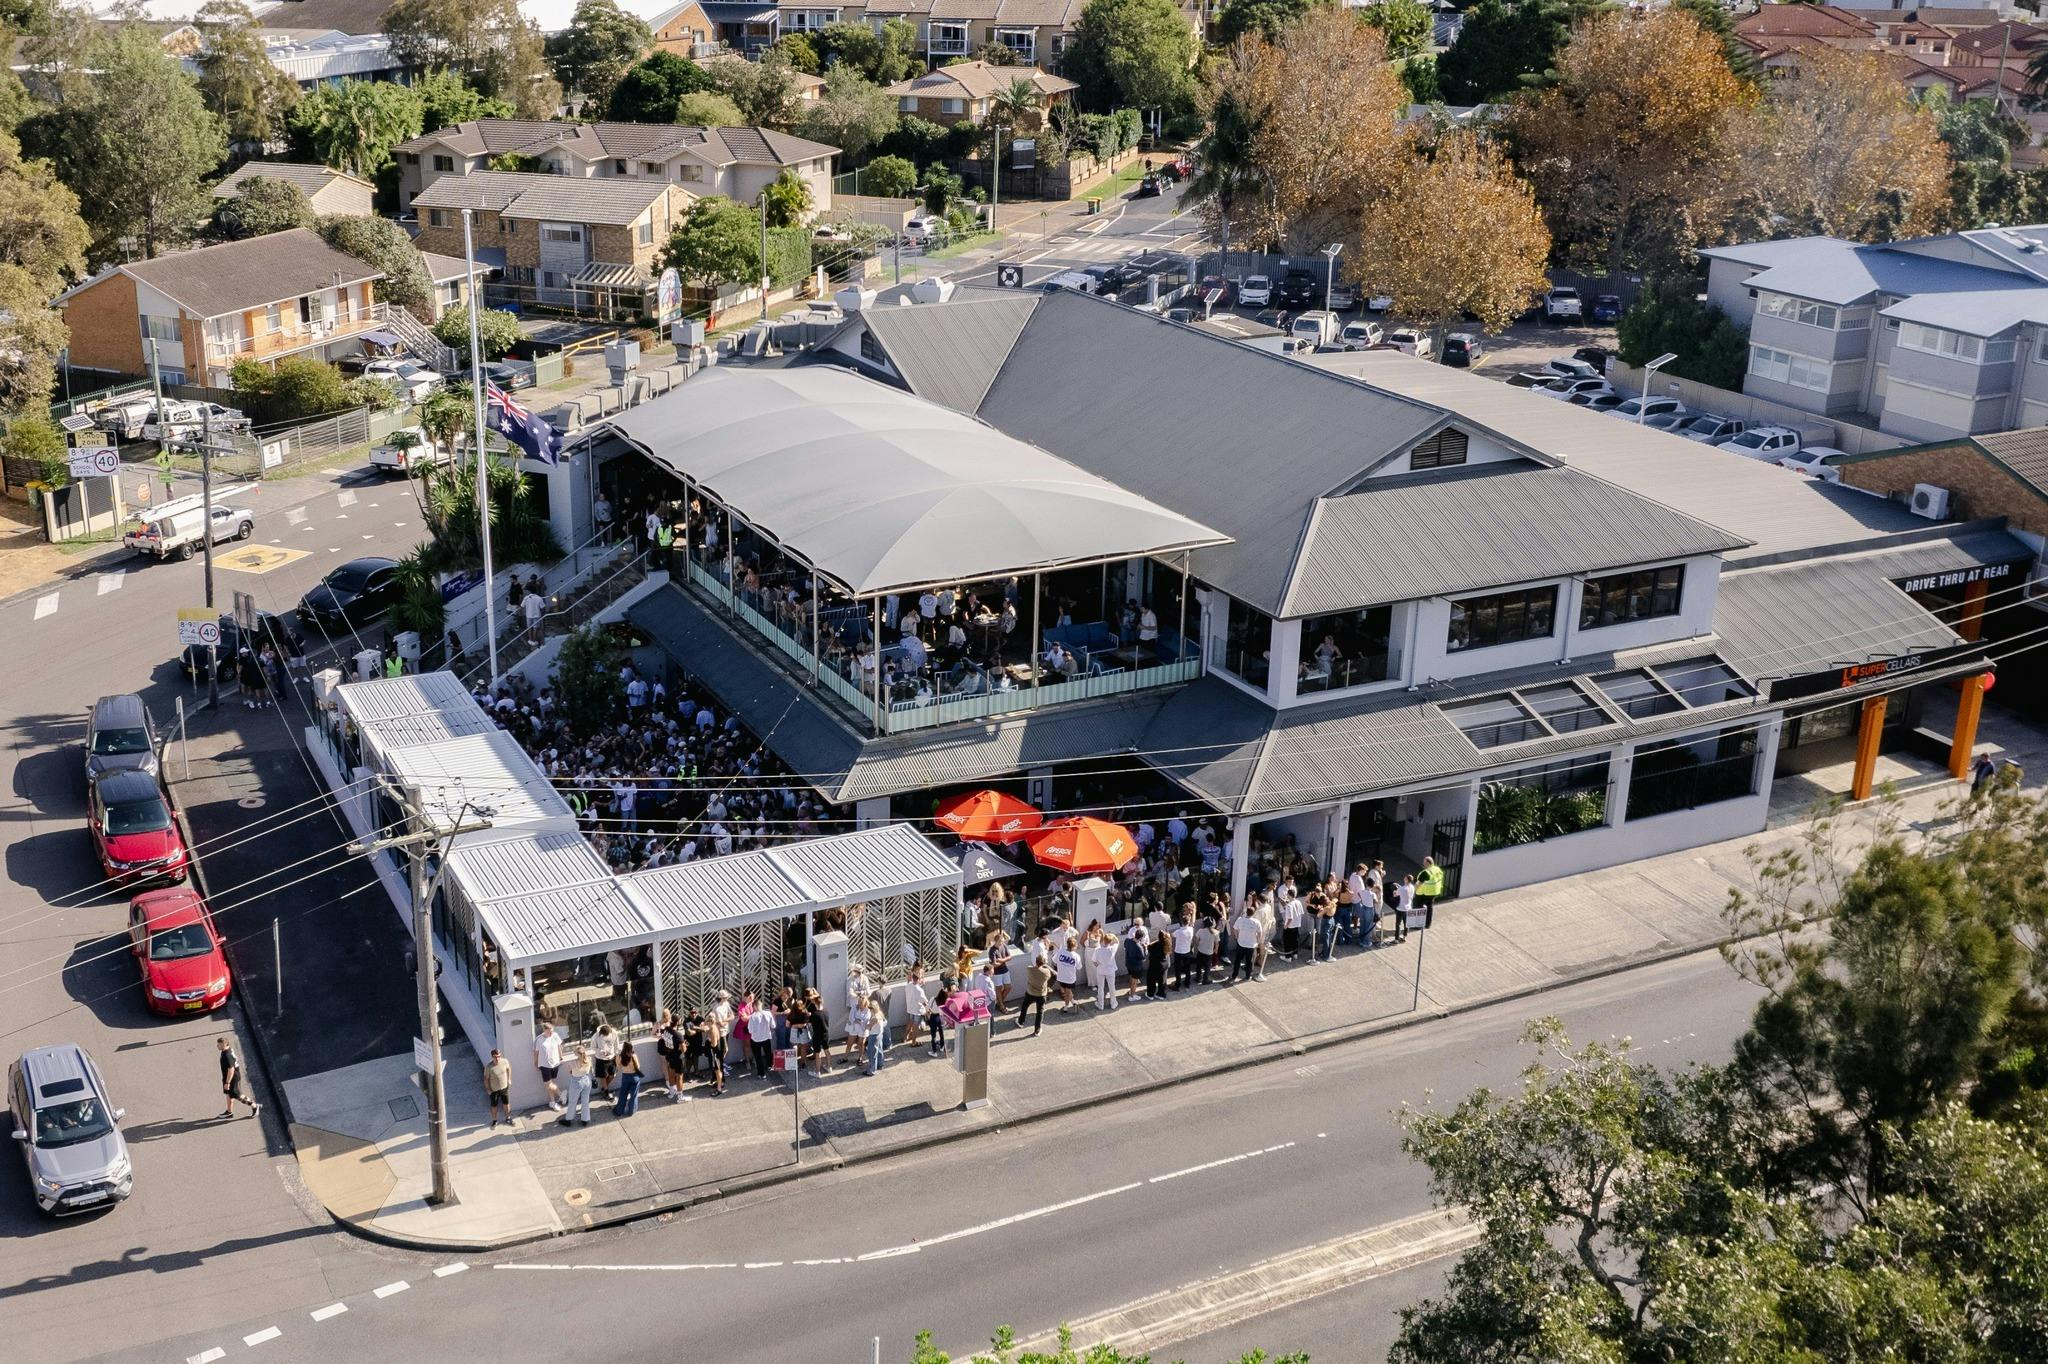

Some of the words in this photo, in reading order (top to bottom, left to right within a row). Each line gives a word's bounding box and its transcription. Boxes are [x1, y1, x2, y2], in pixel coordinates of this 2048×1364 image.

[98, 456, 115, 466] 40
[1905, 576, 1936, 593] DRIVE
[1939, 571, 1966, 587] THRU
[1967, 569, 1981, 582] AT
[1983, 564, 2010, 579] REAR
[203, 628, 216, 637] 40
[1860, 655, 1922, 677] SUPERCELLARS
[1045, 846, 1073, 856] APEROL
[976, 869, 994, 880] DRY
